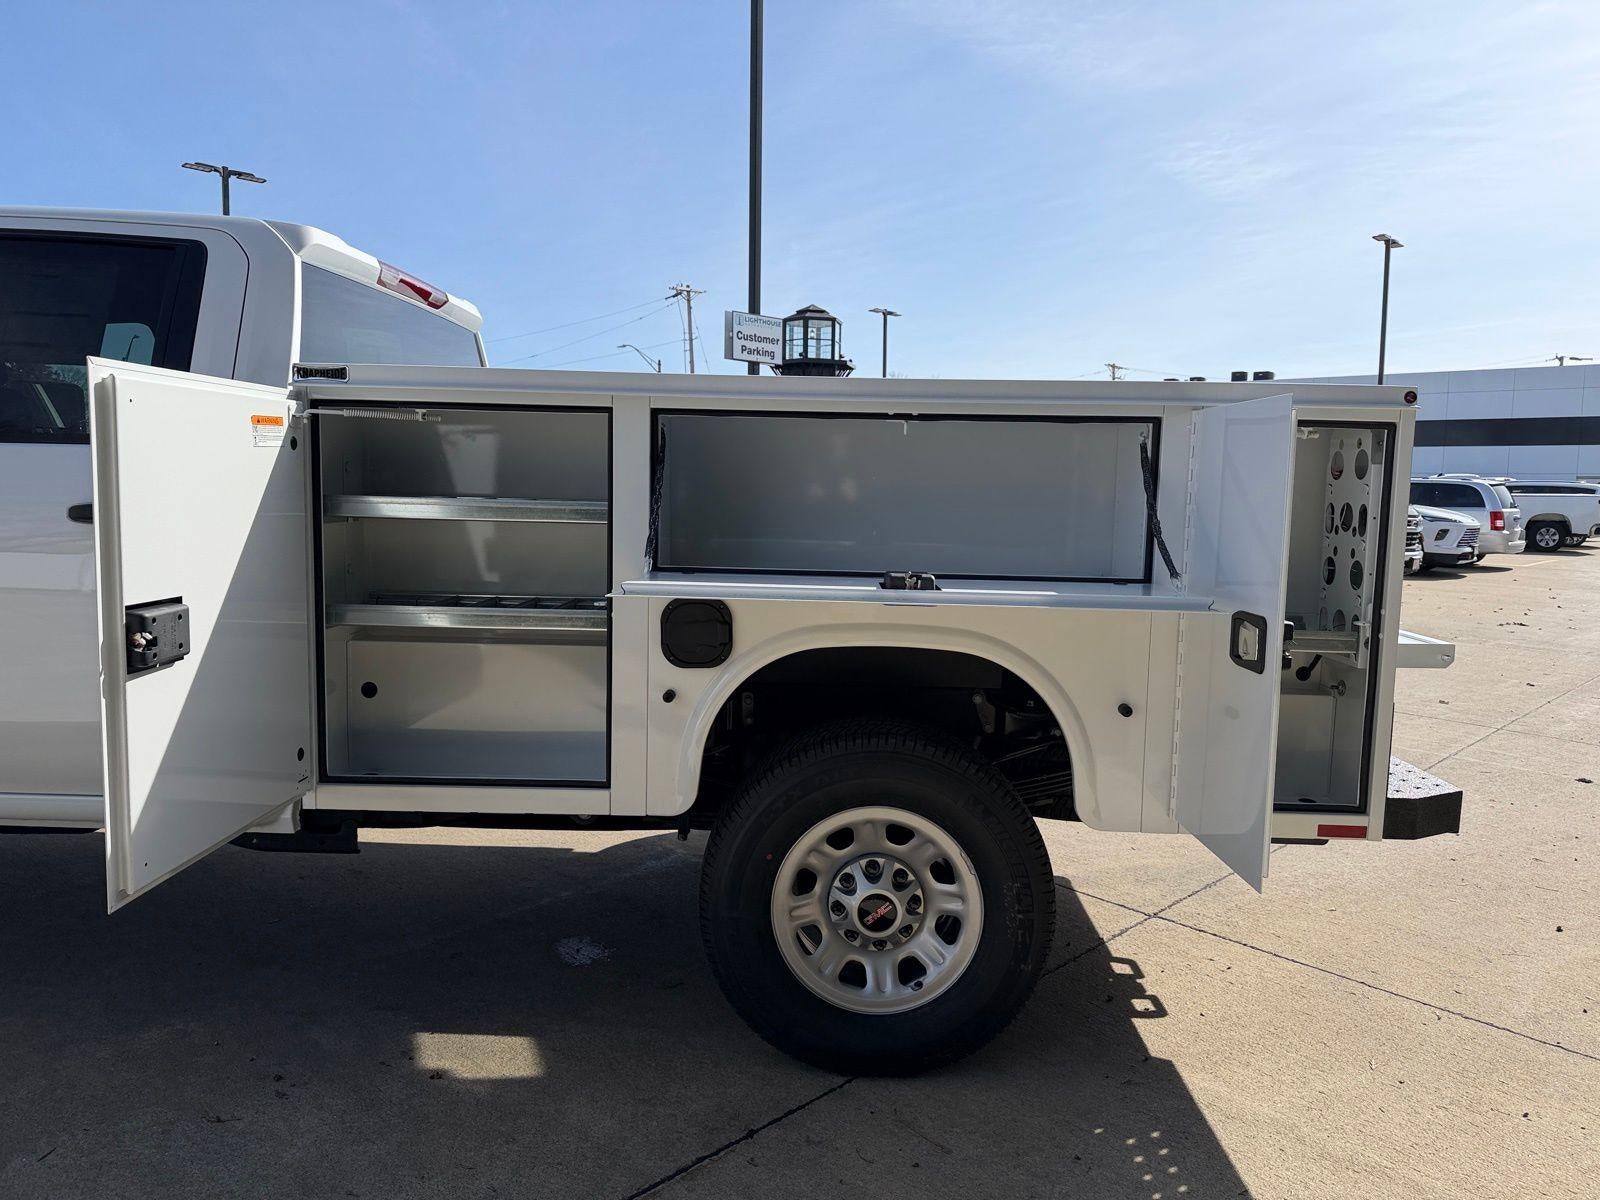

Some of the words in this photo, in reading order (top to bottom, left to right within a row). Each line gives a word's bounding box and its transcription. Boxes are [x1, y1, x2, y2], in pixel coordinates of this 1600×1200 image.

[736, 330, 780, 345] Customer
[741, 345, 775, 360] Parking
[295, 366, 347, 380] KNAPHEIDE
[863, 901, 893, 926] GMC
